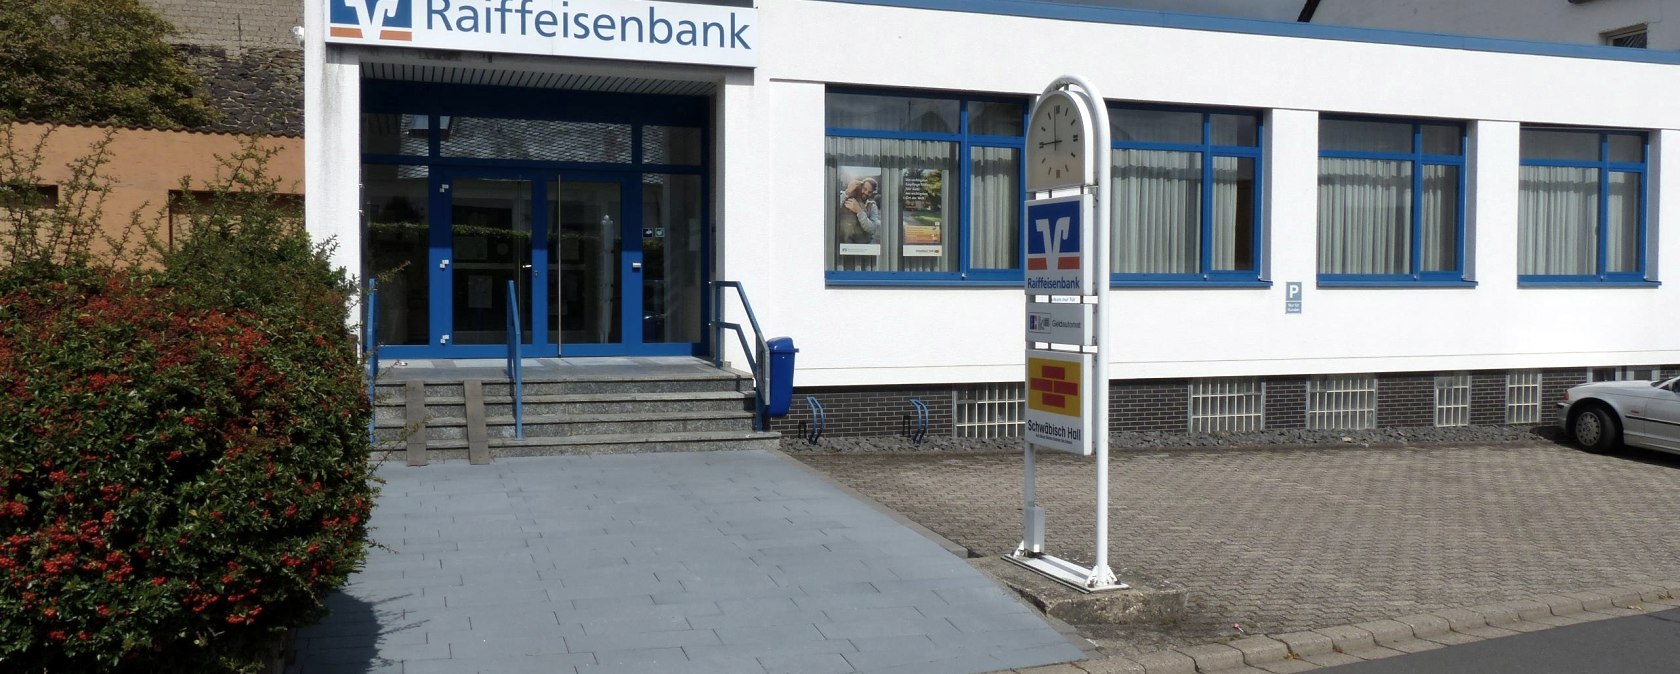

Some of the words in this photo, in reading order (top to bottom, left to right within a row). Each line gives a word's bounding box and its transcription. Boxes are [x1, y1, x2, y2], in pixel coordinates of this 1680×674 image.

[426, 0, 752, 50] Raiffeisenbank
[1027, 276, 1080, 289] Raiffeisenbank
[1289, 284, 1299, 298] P
[1052, 319, 1081, 328] Geldautomat
[1027, 420, 1066, 437] Schwäbisch
[1067, 427, 1081, 441] Hall
